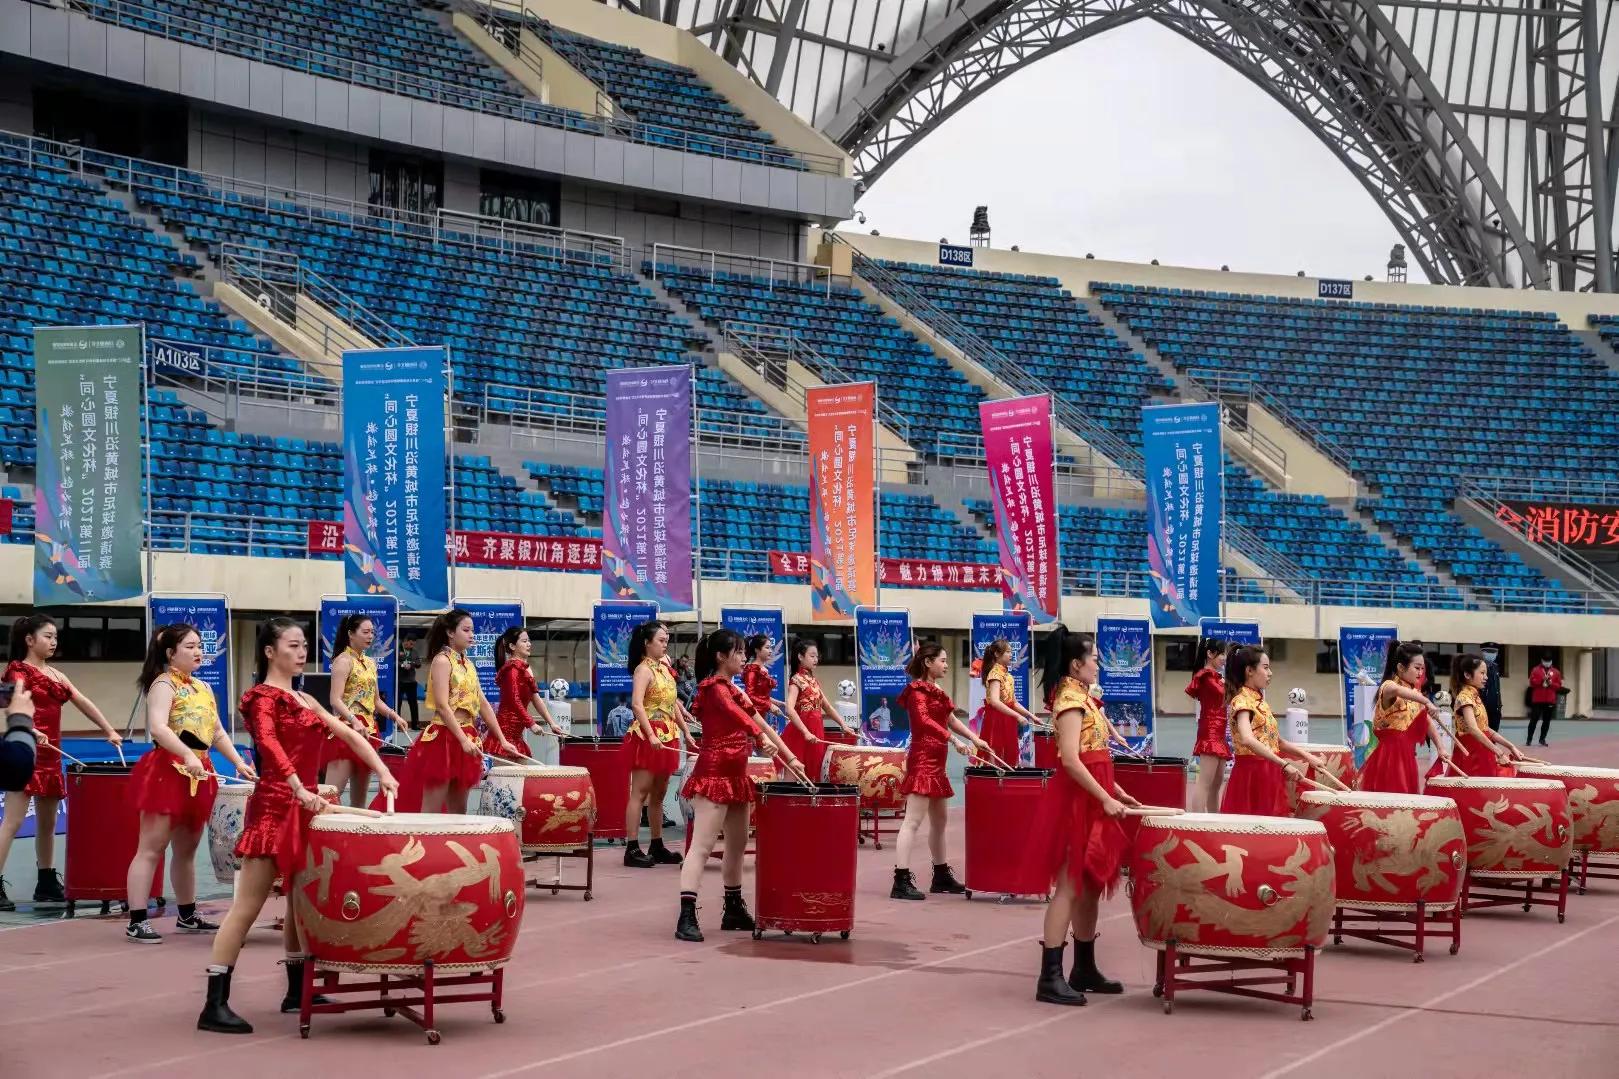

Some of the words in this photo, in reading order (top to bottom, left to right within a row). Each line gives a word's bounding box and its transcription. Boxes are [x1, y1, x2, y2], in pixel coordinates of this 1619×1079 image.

[941, 248, 971, 263] D138区
[1320, 282, 1351, 295] D137区
[155, 347, 200, 370] A103区
[321, 524, 339, 548] 沿
[482, 537, 602, 565] 齐聚银川角逐绿
[780, 554, 808, 573] 全民
[557, 715, 571, 723] 199
